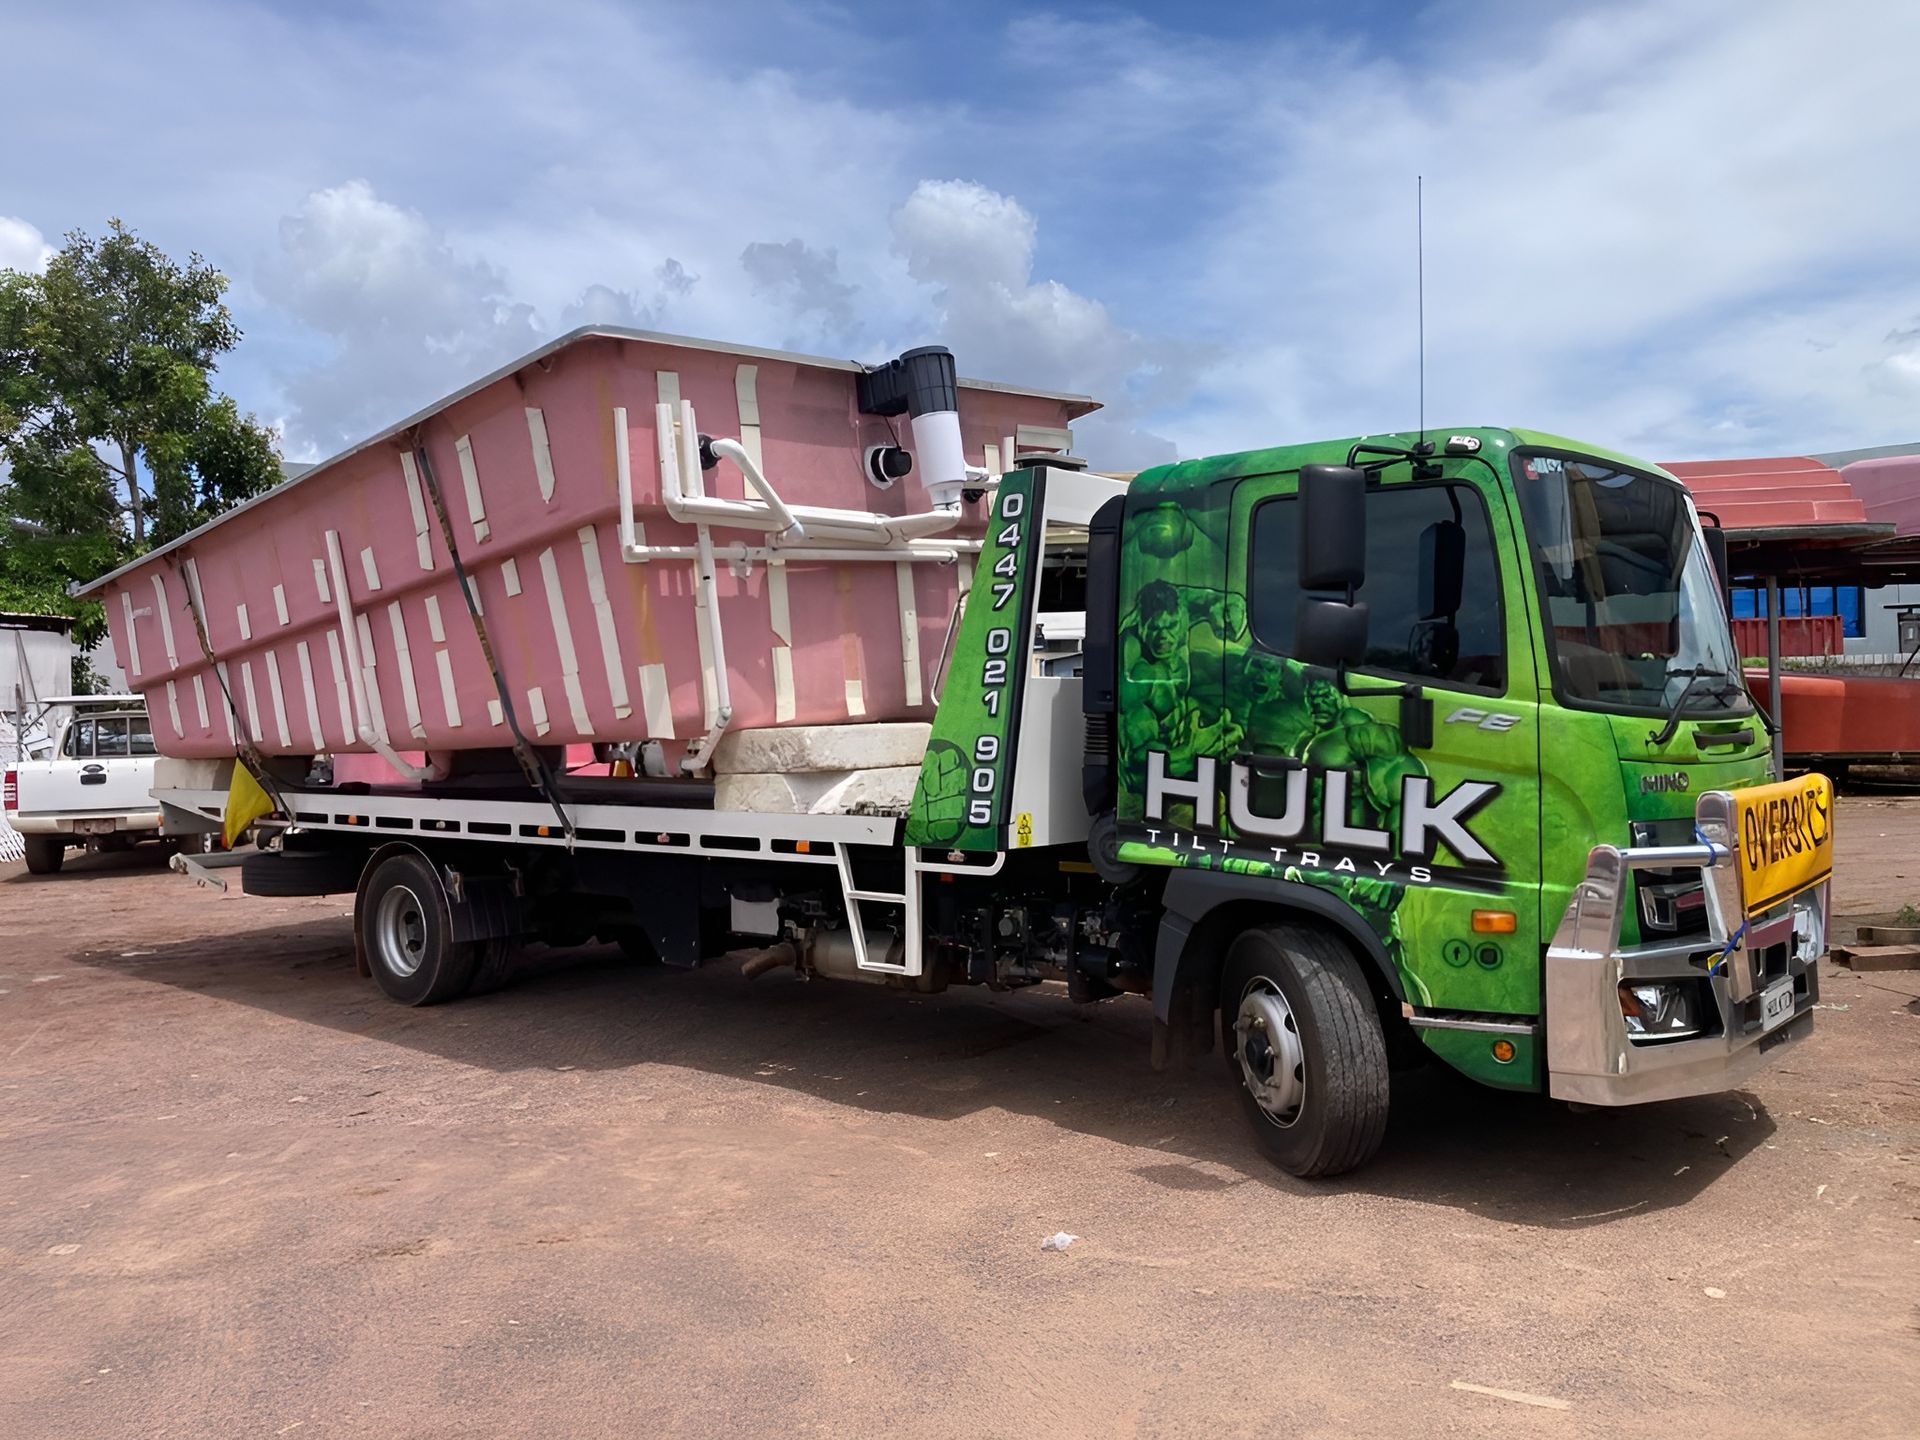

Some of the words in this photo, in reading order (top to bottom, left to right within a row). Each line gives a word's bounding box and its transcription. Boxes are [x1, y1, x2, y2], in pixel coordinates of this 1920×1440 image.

[993, 493, 1024, 610] 0447
[983, 628, 1010, 717] 021
[1444, 708, 1522, 732] FE
[968, 736, 999, 825] 905
[1145, 750, 1501, 867] HULK
[1147, 829, 1235, 853] TILT
[1270, 847, 1432, 882] TRAYS
[1745, 786, 1829, 871] OVERS
